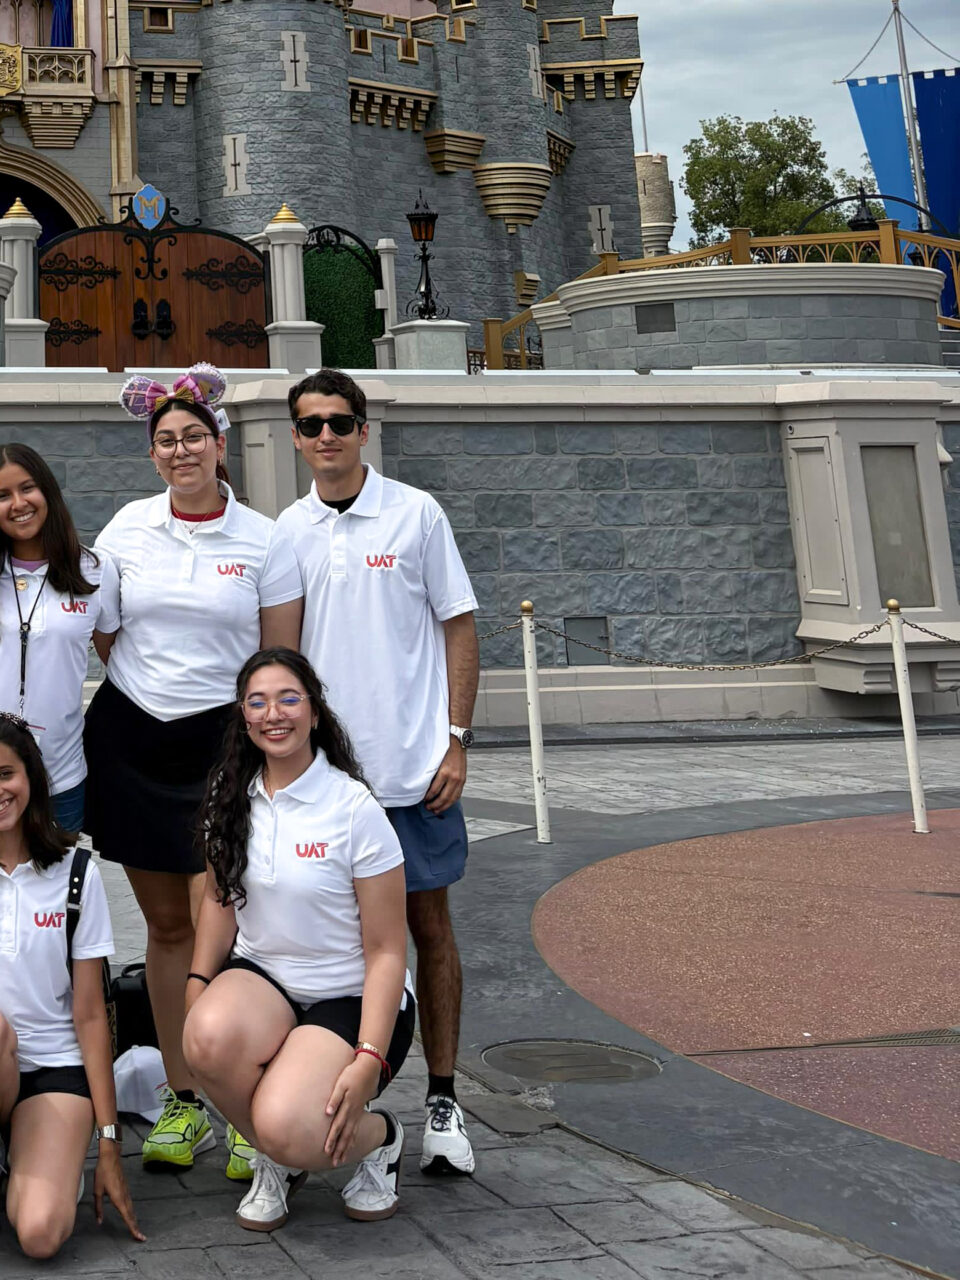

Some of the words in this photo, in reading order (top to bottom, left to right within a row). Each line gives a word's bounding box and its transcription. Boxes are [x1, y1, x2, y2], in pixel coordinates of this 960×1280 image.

[138, 195, 160, 218] M
[365, 554, 398, 569] UAT
[217, 563, 246, 578] UAT
[61, 601, 89, 614] UAT
[295, 842, 329, 859] UAT
[34, 912, 66, 928] UAT
